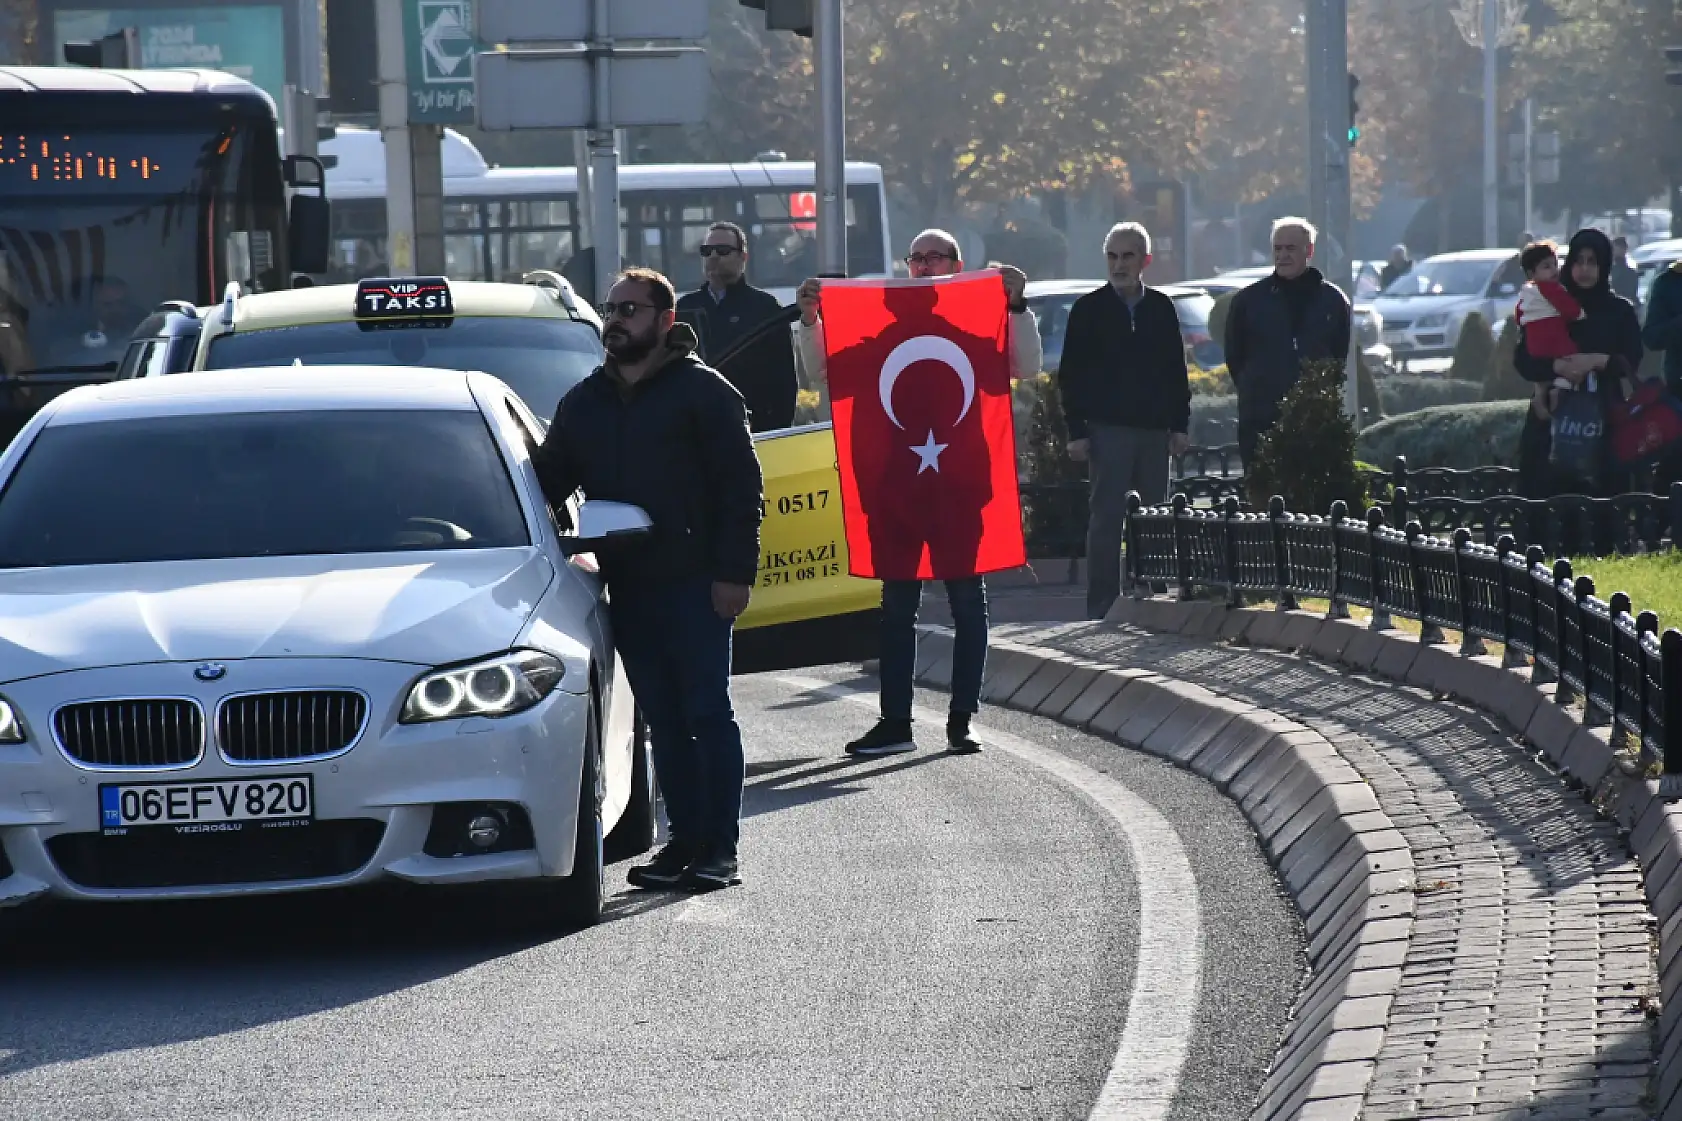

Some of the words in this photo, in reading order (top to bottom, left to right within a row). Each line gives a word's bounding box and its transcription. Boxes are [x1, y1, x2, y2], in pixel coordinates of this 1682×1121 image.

[389, 284, 418, 294] VIP
[777, 490, 829, 515] 0517
[763, 570, 790, 587] 571
[796, 566, 815, 581] 08
[823, 562, 840, 577] 15
[105, 810, 119, 820] TR
